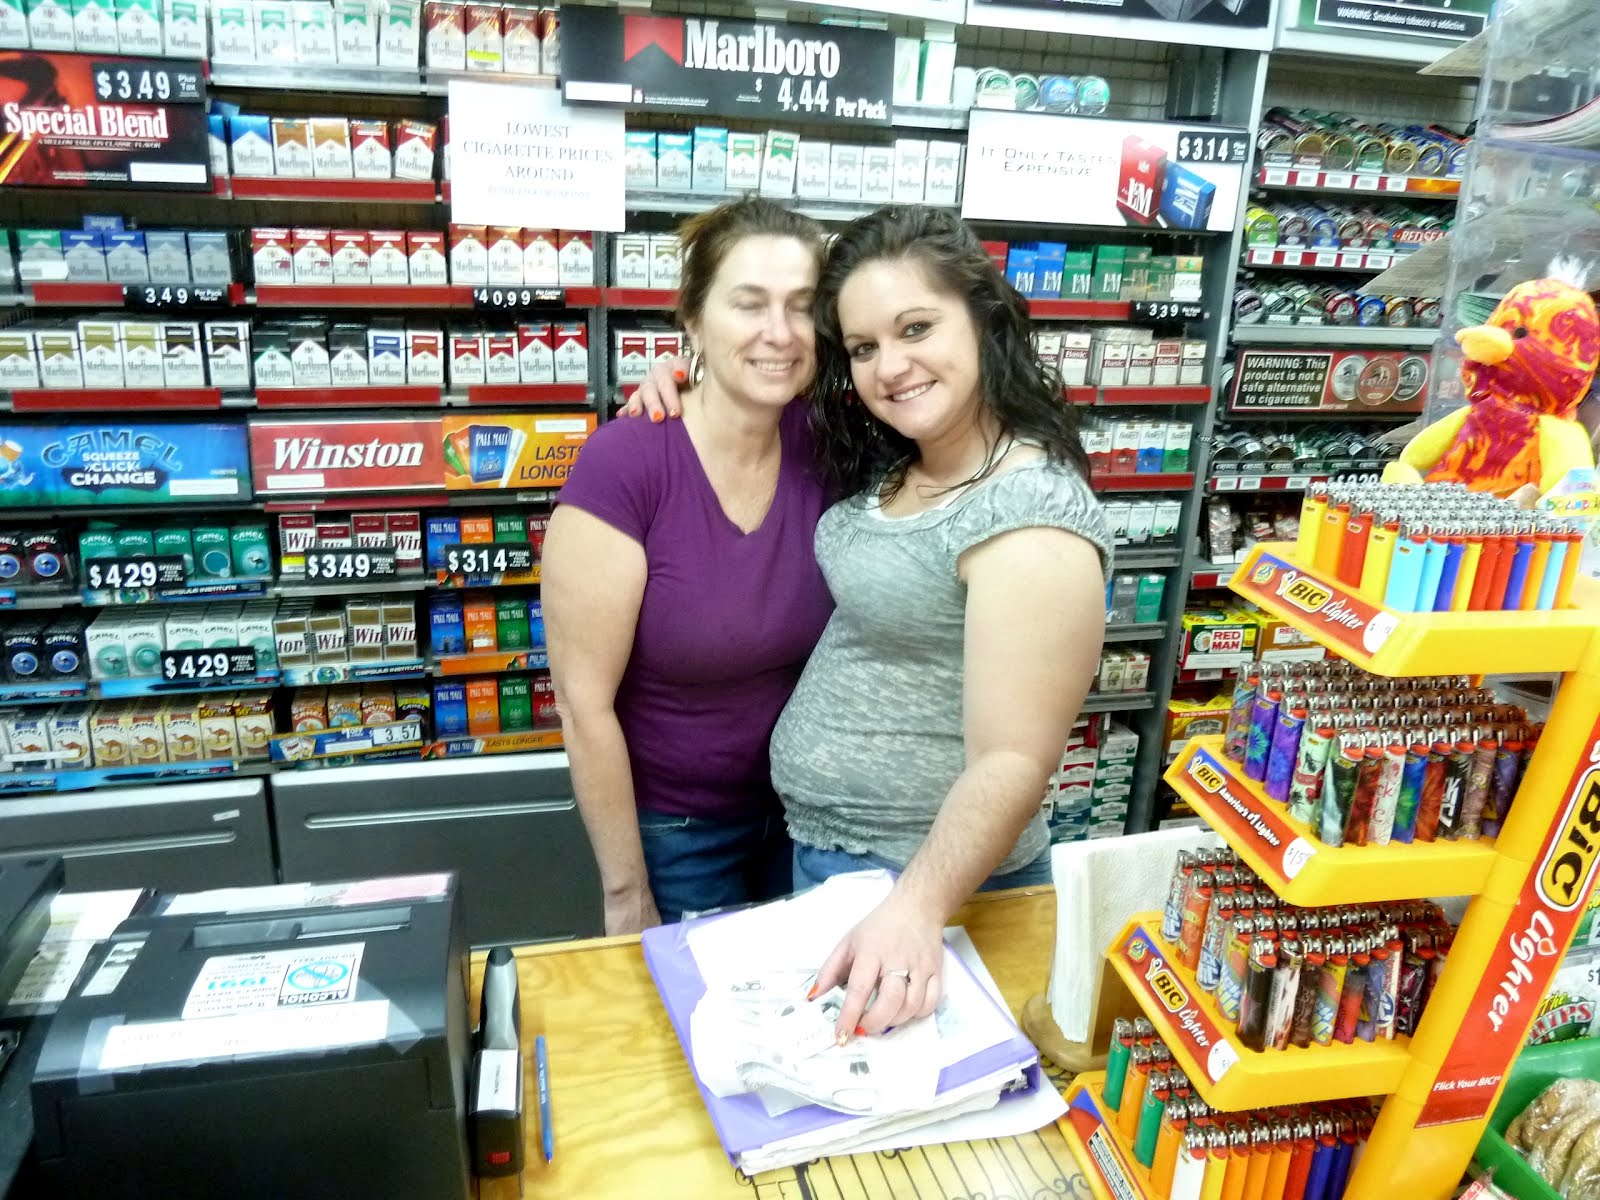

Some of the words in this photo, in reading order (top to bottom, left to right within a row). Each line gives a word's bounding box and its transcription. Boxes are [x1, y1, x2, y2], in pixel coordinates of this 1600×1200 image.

[684, 18, 840, 78] Marlboro
[778, 78, 829, 112] 4.44
[835, 96, 857, 118] Per
[857, 98, 887, 120] Pack
[4, 102, 96, 140] Special
[99, 105, 169, 139] Blend
[506, 122, 571, 138] LOWEST
[463, 140, 555, 158] CIGARETTE
[1005, 147, 1048, 160] ONLY
[1179, 136, 1228, 161] $3.14
[505, 166, 573, 181] AROUND
[1004, 161, 1092, 176] EXPENSIVE
[1065, 350, 1087, 359] Basic
[1156, 357, 1178, 365] Basic
[1247, 358, 1303, 369] WARNING:
[1306, 358, 1327, 369] This
[1244, 371, 1285, 383] product
[1287, 371, 1296, 381] is
[1298, 372, 1314, 381] not
[1241, 382, 1264, 392] safe
[1266, 382, 1320, 393] alternative
[1245, 394, 1256, 404] to
[1258, 394, 1312, 406] cigarettes.
[475, 432, 491, 447] PALL
[492, 432, 508, 446] MALL
[41, 428, 183, 472] CAMEL
[82, 452, 140, 462] SQUEEZE
[273, 437, 424, 470] Winston
[70, 471, 157, 486] CHANGE
[520, 465, 574, 480] LONGE
[24, 536, 57, 548] CAMEL
[448, 548, 507, 573] $3.14
[1321, 599, 1365, 630] Lighter
[5, 636, 38, 647] CAMEL
[45, 635, 78, 645] CAMEL
[1213, 631, 1241, 640] RED
[1212, 641, 1240, 650] MAN
[1218, 787, 1249, 818] America's
[1254, 820, 1281, 847] Lighter
[1487, 909, 1556, 1032] Lighter
[281, 989, 349, 1005] ALCOHOL
[1540, 991, 1569, 1017] The
[1178, 1009, 1210, 1047] Lighter
[1530, 1003, 1593, 1042] HIPS
[1433, 1080, 1455, 1091] Flick
[1457, 1079, 1477, 1088] Your
